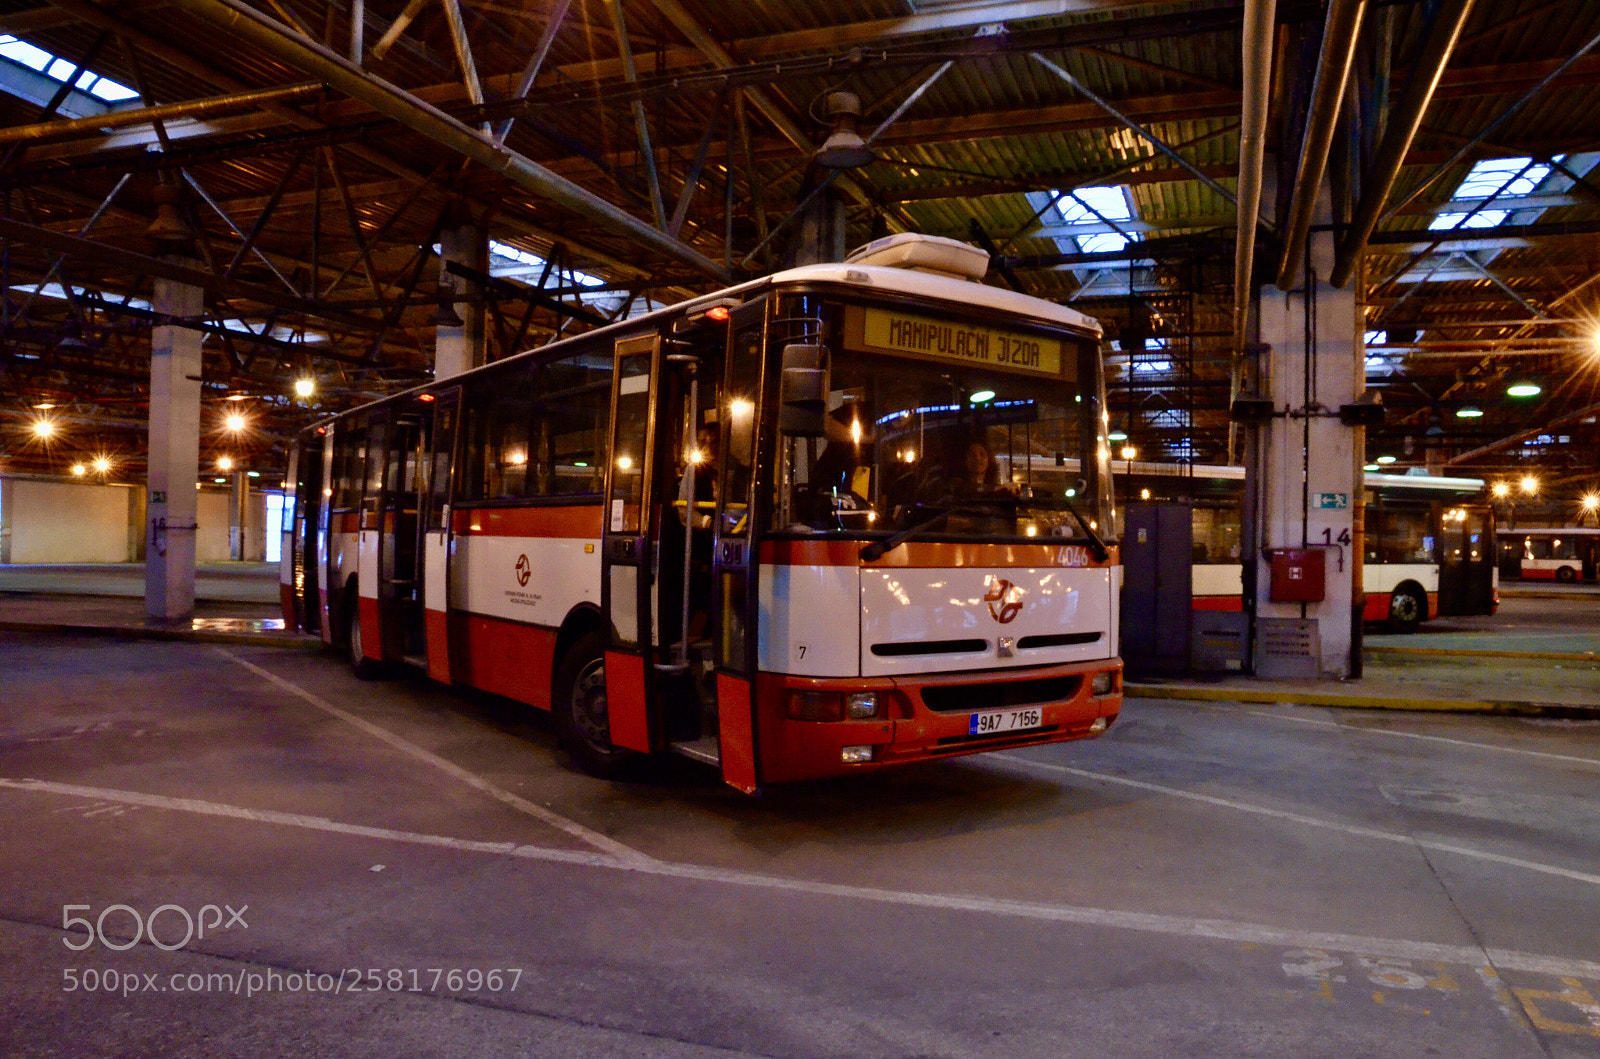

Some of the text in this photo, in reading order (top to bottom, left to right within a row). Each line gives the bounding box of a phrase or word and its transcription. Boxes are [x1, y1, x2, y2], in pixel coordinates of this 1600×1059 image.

[1321, 527, 1352, 546] 14
[1057, 546, 1089, 566] 4046
[799, 646, 807, 660] 7
[980, 710, 1039, 732] 9A7 7156
